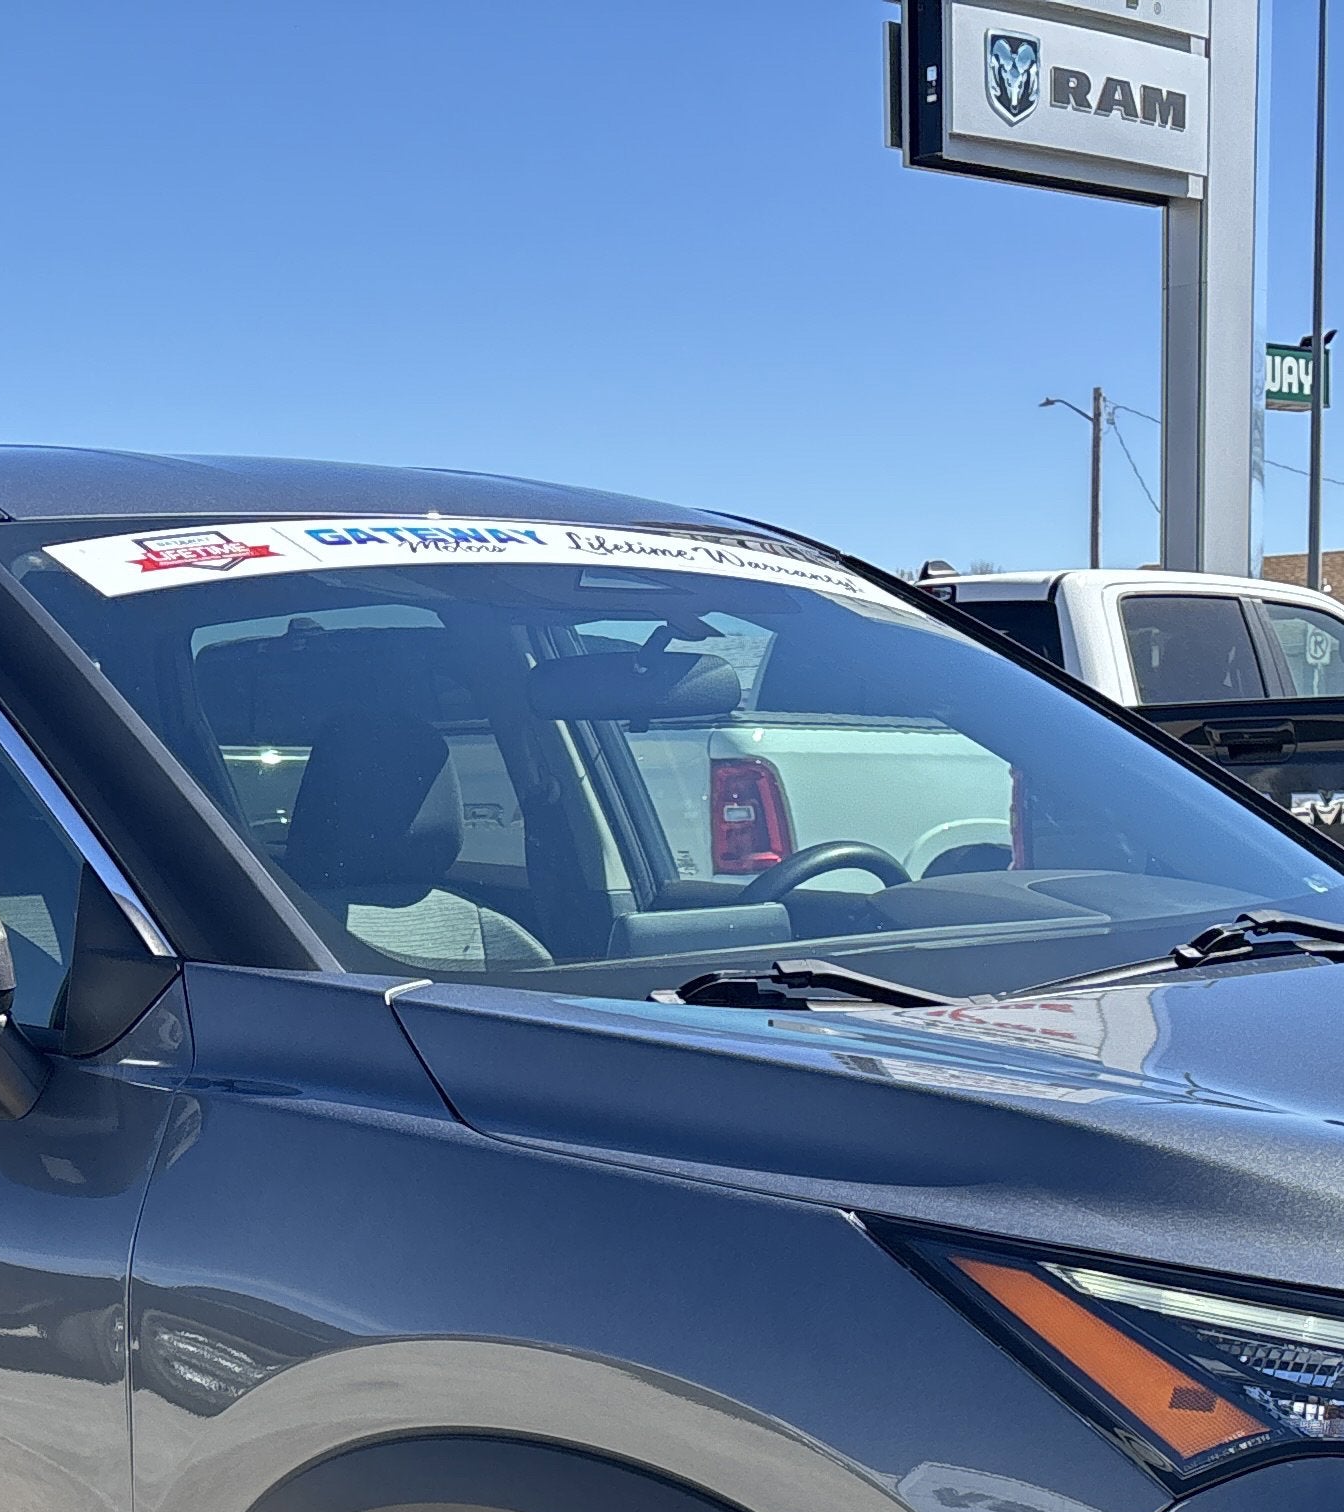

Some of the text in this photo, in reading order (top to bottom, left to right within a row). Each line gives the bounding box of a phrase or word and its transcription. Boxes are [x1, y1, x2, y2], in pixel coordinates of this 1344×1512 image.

[1050, 66, 1187, 132] RAM
[304, 527, 549, 546] GATEWAY
[398, 539, 507, 553] Motors
[565, 531, 695, 561] Lifetime
[145, 541, 247, 562] LIFETIME
